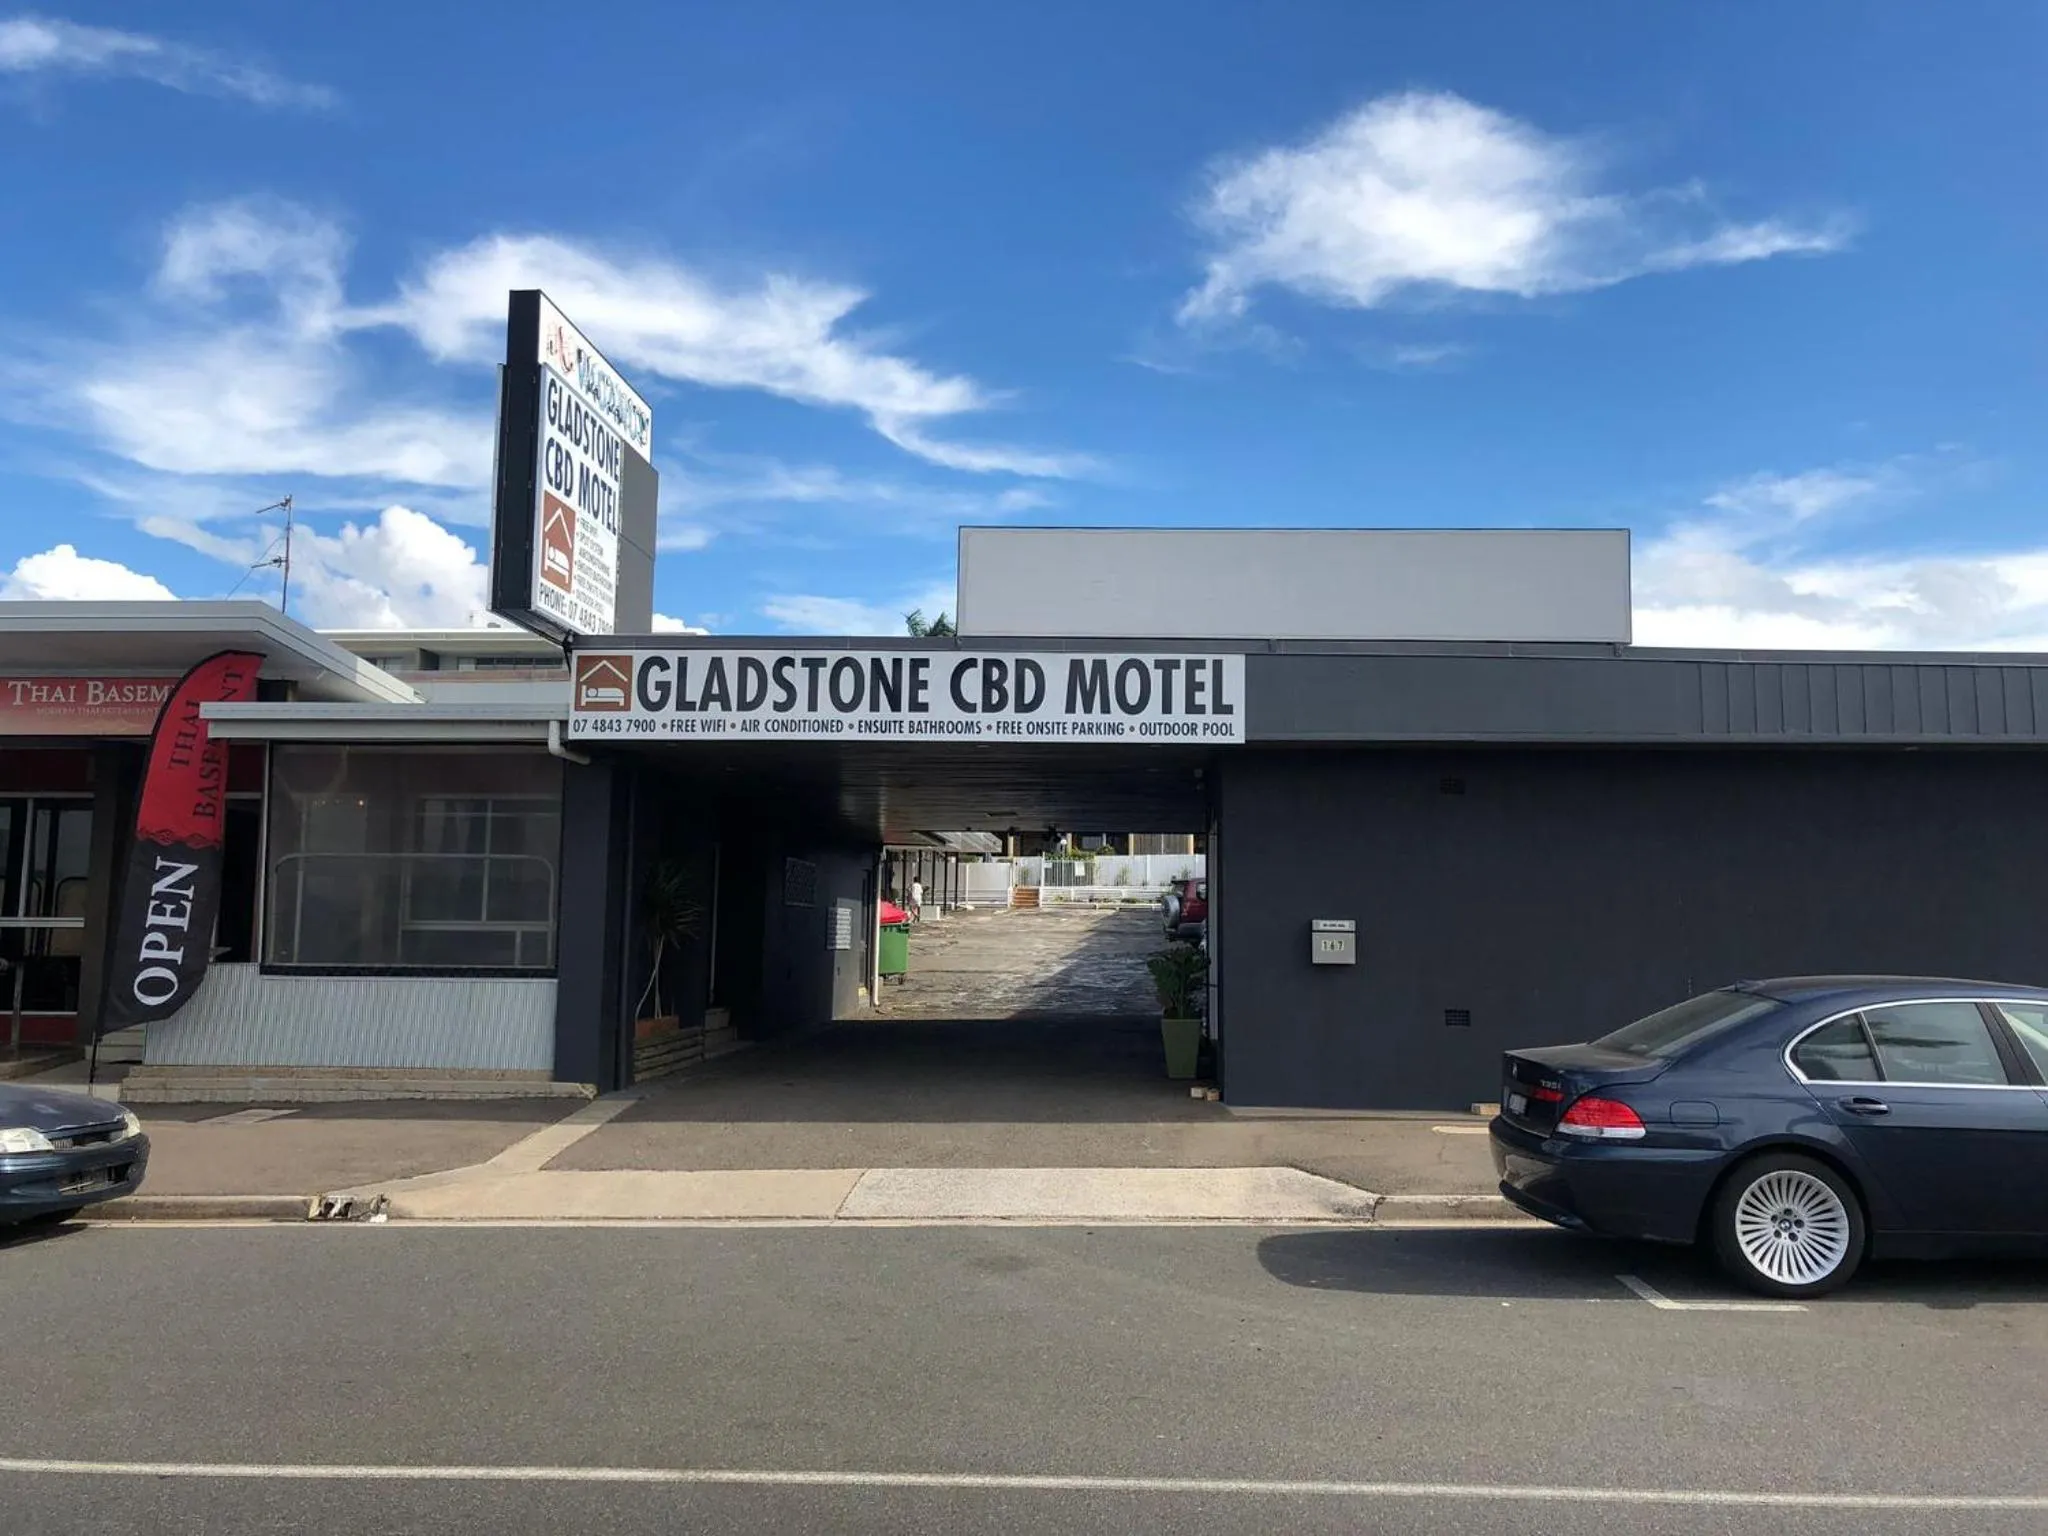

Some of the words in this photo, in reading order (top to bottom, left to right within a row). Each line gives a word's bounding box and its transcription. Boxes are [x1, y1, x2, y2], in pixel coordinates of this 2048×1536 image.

[547, 378, 619, 482] GLADSTONE
[546, 437, 573, 498] CBD
[578, 462, 616, 536] MOTEL
[539, 582, 567, 616] PHONE:
[568, 600, 578, 622] 07
[579, 608, 597, 633] 4843
[8, 681, 76, 705] THAI
[86, 681, 171, 705] BASEM
[636, 655, 930, 714] GLADSTONE
[949, 657, 1046, 714] CBD
[1064, 657, 1234, 715] MOTEL
[166, 699, 201, 770] THAI
[192, 665, 243, 819] BASENT
[573, 719, 590, 733] 07
[592, 719, 622, 733] 4843
[626, 719, 656, 733] 7900
[670, 719, 697, 733] FREE
[700, 719, 726, 733] WIFI
[740, 719, 760, 733] AIR
[764, 719, 843, 734] CONDITIONED
[858, 720, 904, 734] ENSUITE
[908, 720, 982, 735] BATHROOMS
[996, 721, 1023, 735] FREE
[1026, 721, 1068, 735] ONSITE
[1072, 721, 1125, 736] PARKING
[1139, 722, 1198, 736] OUTDOOR
[1203, 722, 1235, 736] POOL
[133, 856, 199, 1006] OPEN
